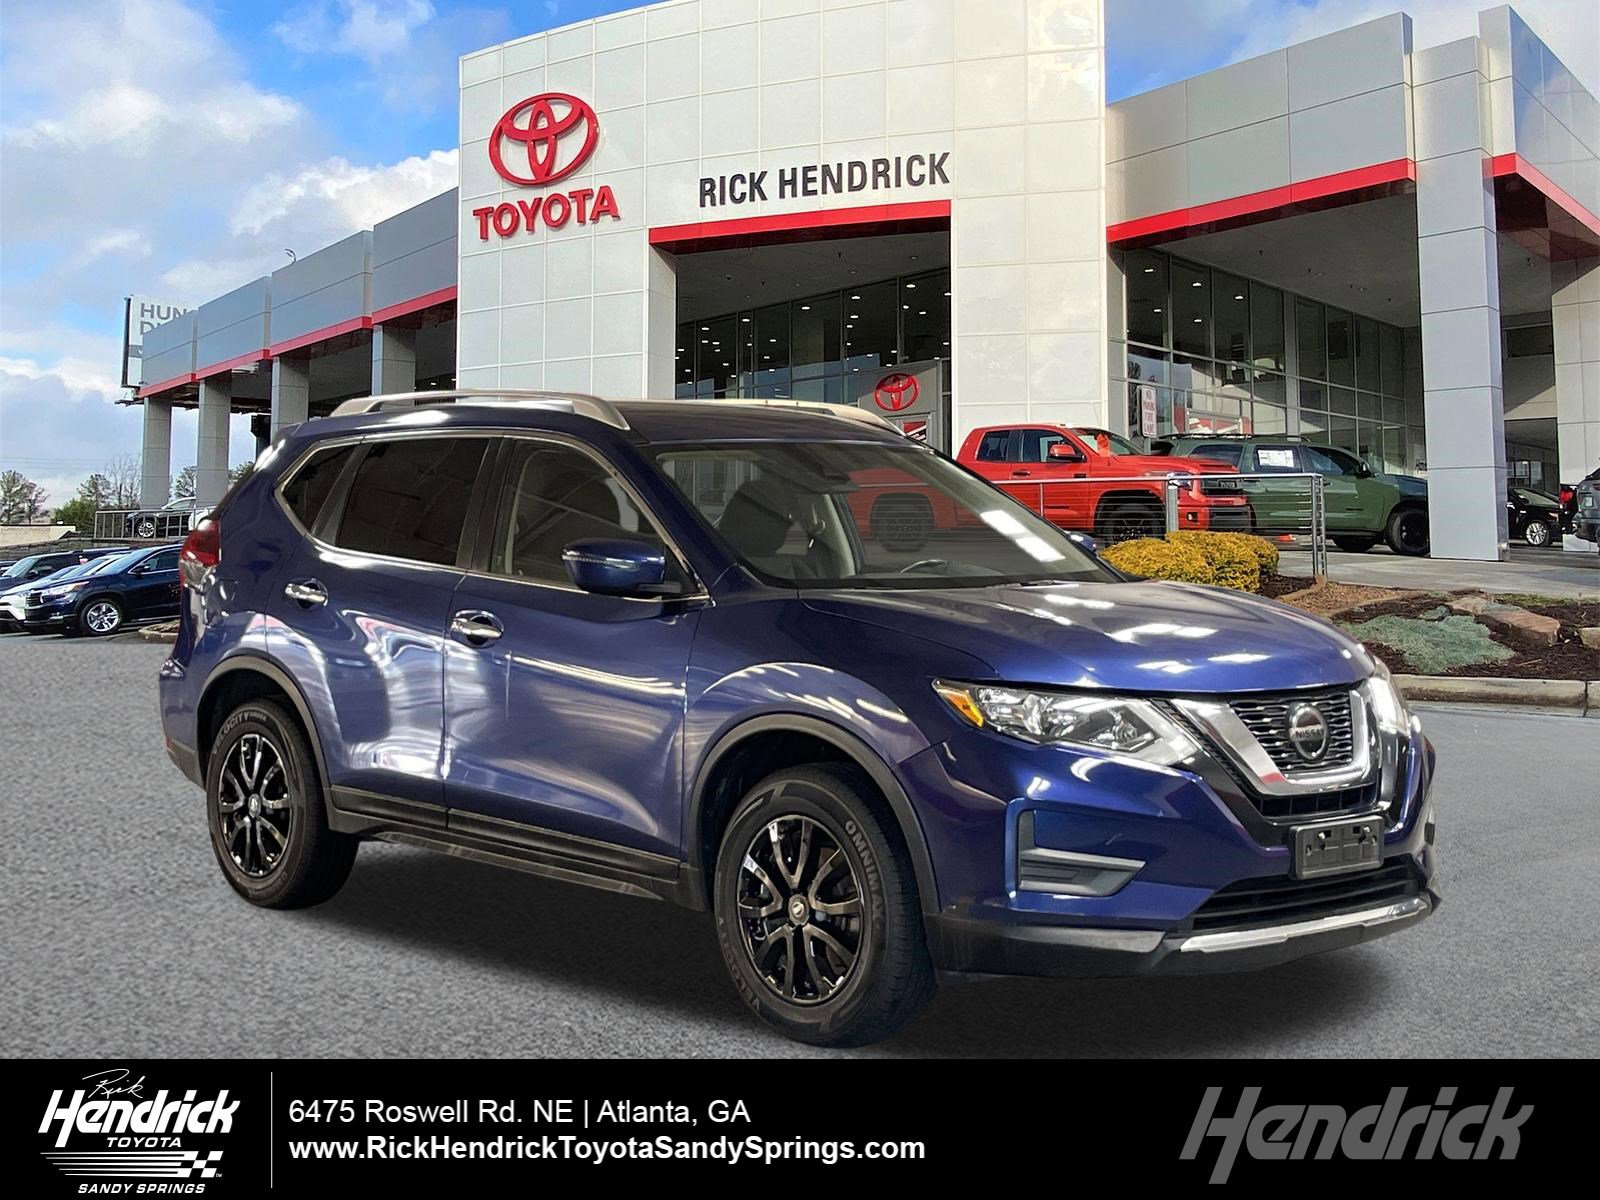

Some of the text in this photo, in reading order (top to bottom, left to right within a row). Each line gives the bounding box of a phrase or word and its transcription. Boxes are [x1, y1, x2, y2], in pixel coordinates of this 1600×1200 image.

[699, 151, 951, 208] RICK HENDRICK
[473, 185, 621, 241] TOYOTA
[1295, 727, 1325, 739] NISSAN
